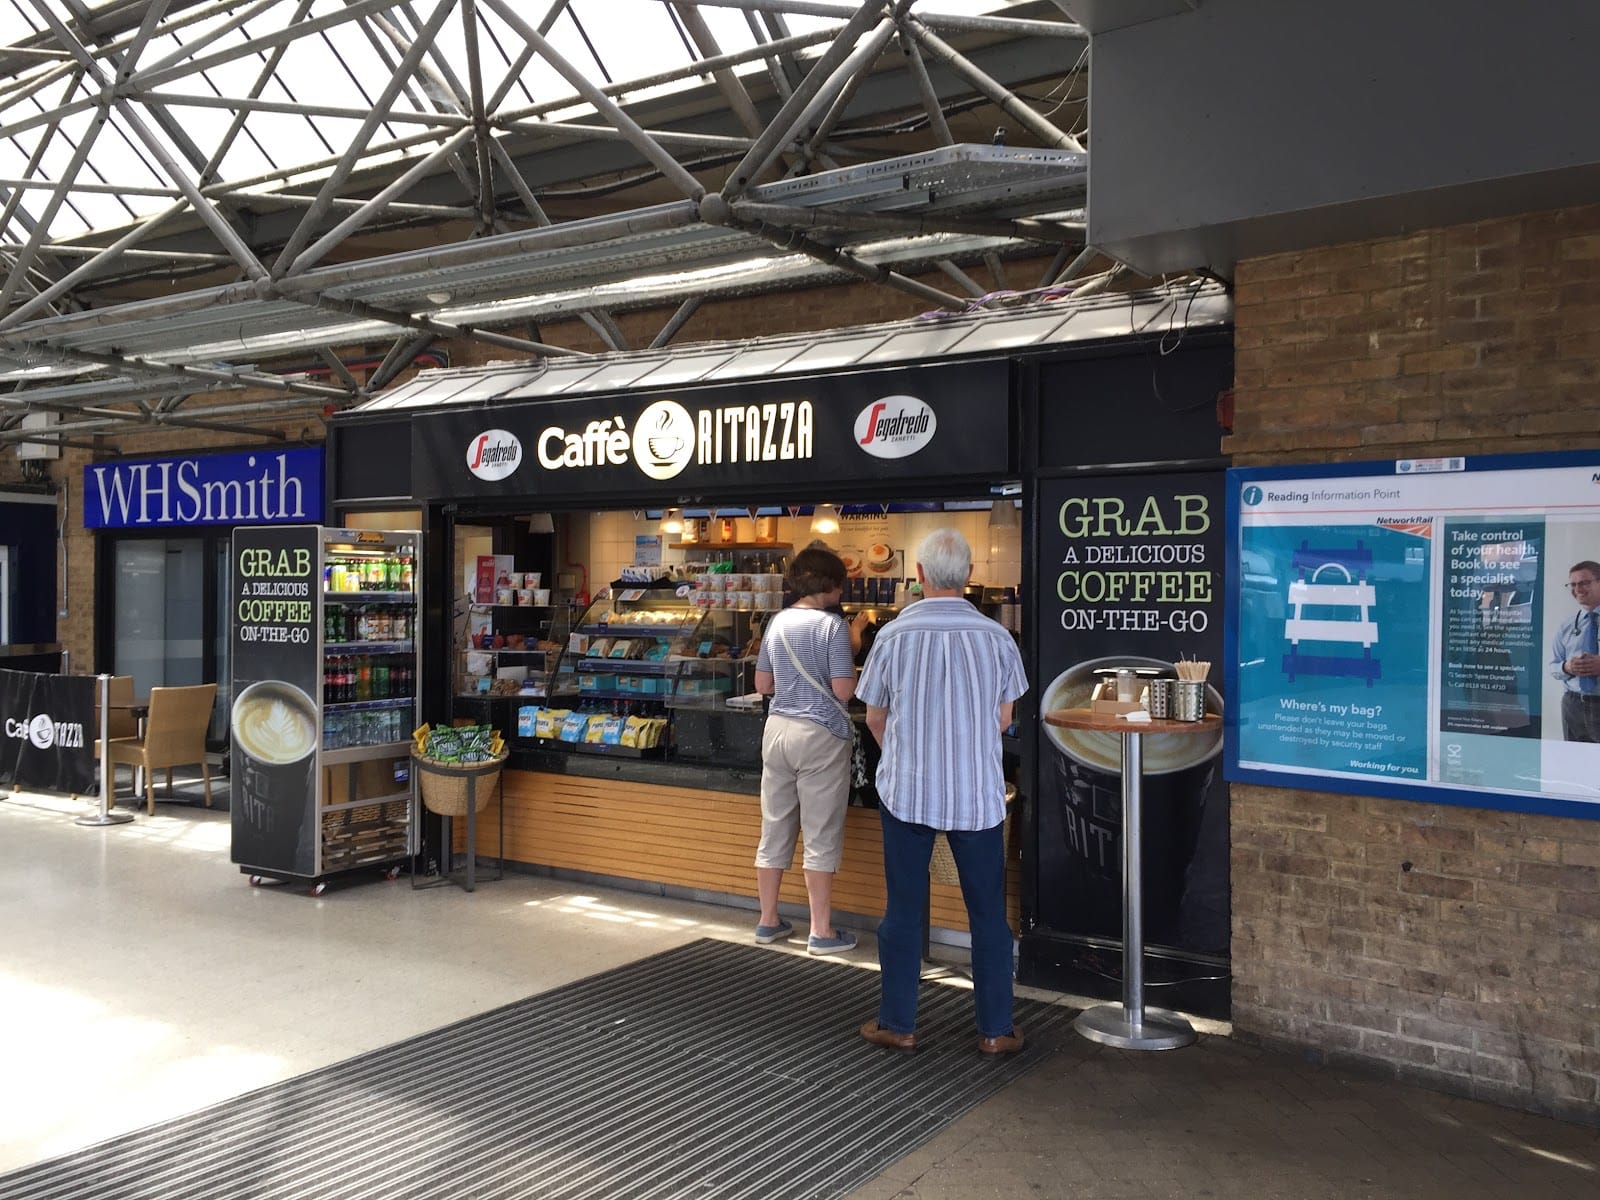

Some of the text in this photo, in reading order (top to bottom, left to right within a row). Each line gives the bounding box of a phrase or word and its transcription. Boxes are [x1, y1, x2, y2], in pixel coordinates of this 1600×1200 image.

[860, 403, 929, 445] Segafredo
[537, 400, 813, 470] Caffè RITAZZA
[471, 435, 518, 469] Segafredo
[93, 454, 306, 525] WHSmith
[1267, 492, 1308, 503] Reading
[1311, 489, 1370, 501] Information
[1374, 488, 1400, 499] Point
[1058, 494, 1211, 538] GRAB
[1451, 529, 1523, 541] Take control
[1062, 544, 1205, 564] A DELICIOUS
[1451, 543, 1539, 558] of your health.
[240, 548, 311, 577] GRAB
[1451, 559, 1520, 569] Book to see
[1056, 571, 1212, 602] COFFEE
[1451, 573, 1515, 586] a specialist
[241, 582, 308, 596] A DELICIOUS
[1450, 587, 1486, 600] today.
[238, 599, 311, 623] COFFEE
[1060, 608, 1208, 632] ON-THE-GO
[240, 626, 310, 643] ON-THE-GO
[1499, 664, 1526, 672] specialist
[1329, 704, 1347, 716] my
[1351, 704, 1382, 719] bag?
[1274, 713, 1299, 723] Please
[1324, 717, 1344, 726] leave
[1346, 719, 1365, 728] your
[1367, 720, 1387, 731] bags
[1258, 723, 1302, 733] unattended
[1315, 725, 1331, 737] they
[1333, 729, 1350, 739] may
[1352, 729, 1364, 738] be
[1365, 731, 1394, 742] moved
[1279, 734, 1382, 751] destroyed by security staff
[1350, 759, 1386, 773] Working
[1387, 763, 1399, 772] for
